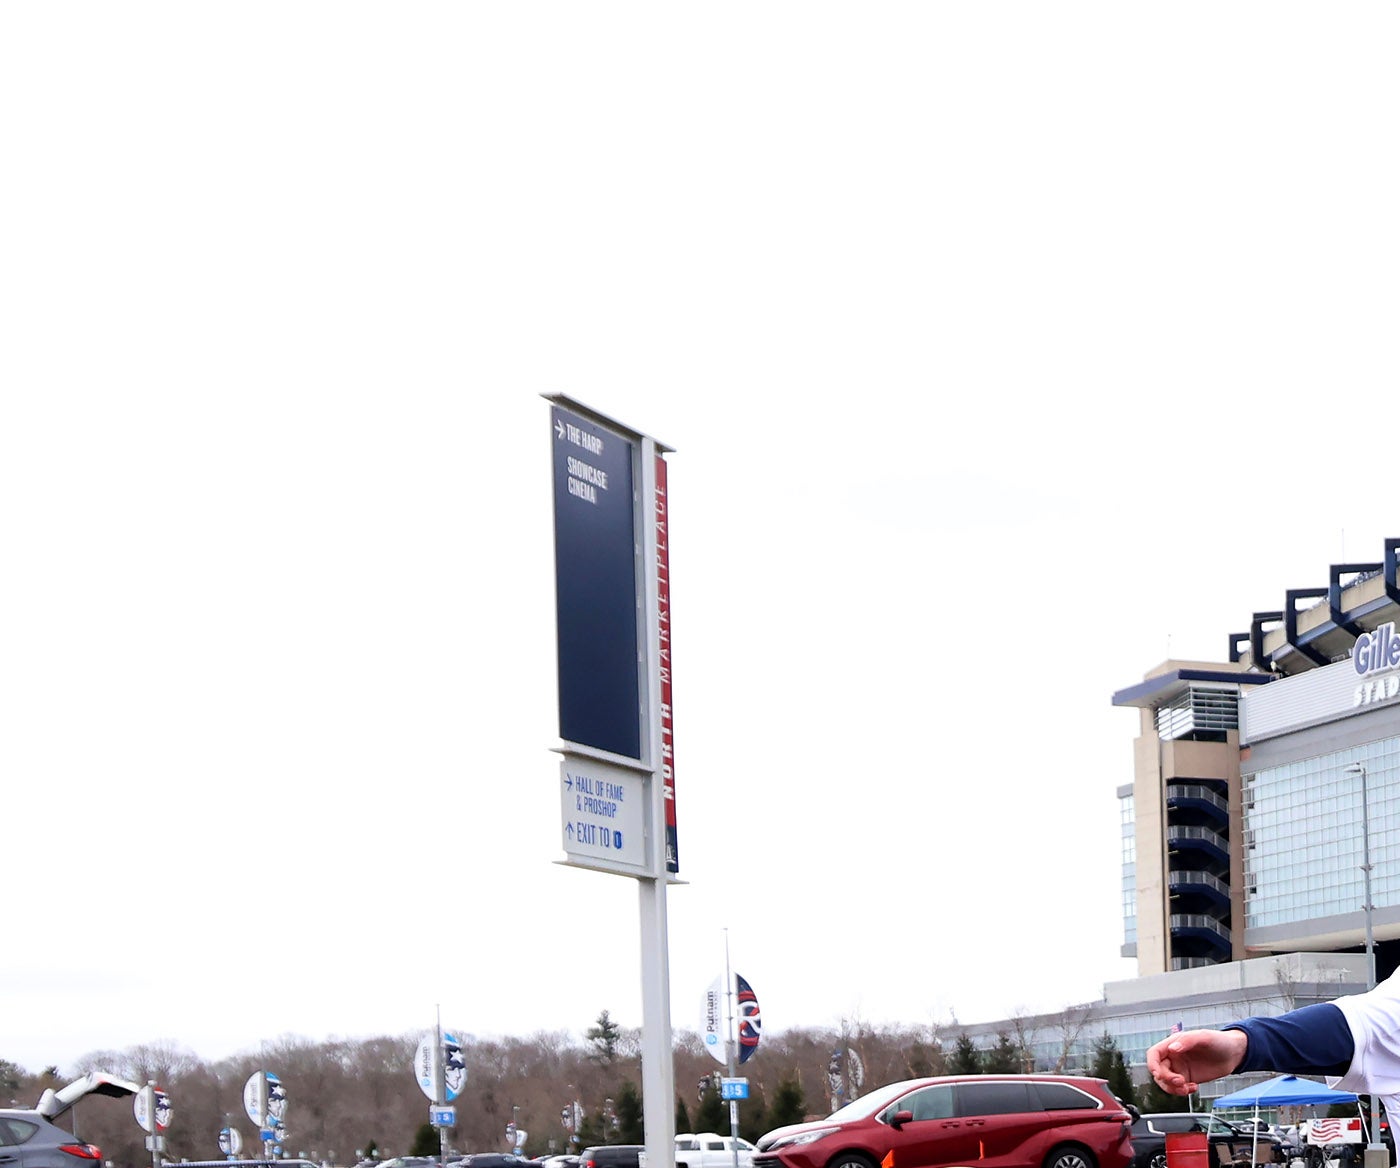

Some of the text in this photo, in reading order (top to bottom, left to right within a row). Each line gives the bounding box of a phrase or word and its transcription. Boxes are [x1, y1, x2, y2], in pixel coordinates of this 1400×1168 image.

[566, 423, 602, 455] THE HARP
[567, 456, 607, 489] SHOWCASE
[568, 476, 595, 504] CINEMA
[575, 776, 624, 802] HALL OF FAME
[584, 796, 617, 818] PROSHOP
[577, 822, 596, 845] EXIT
[598, 826, 610, 848] TO
